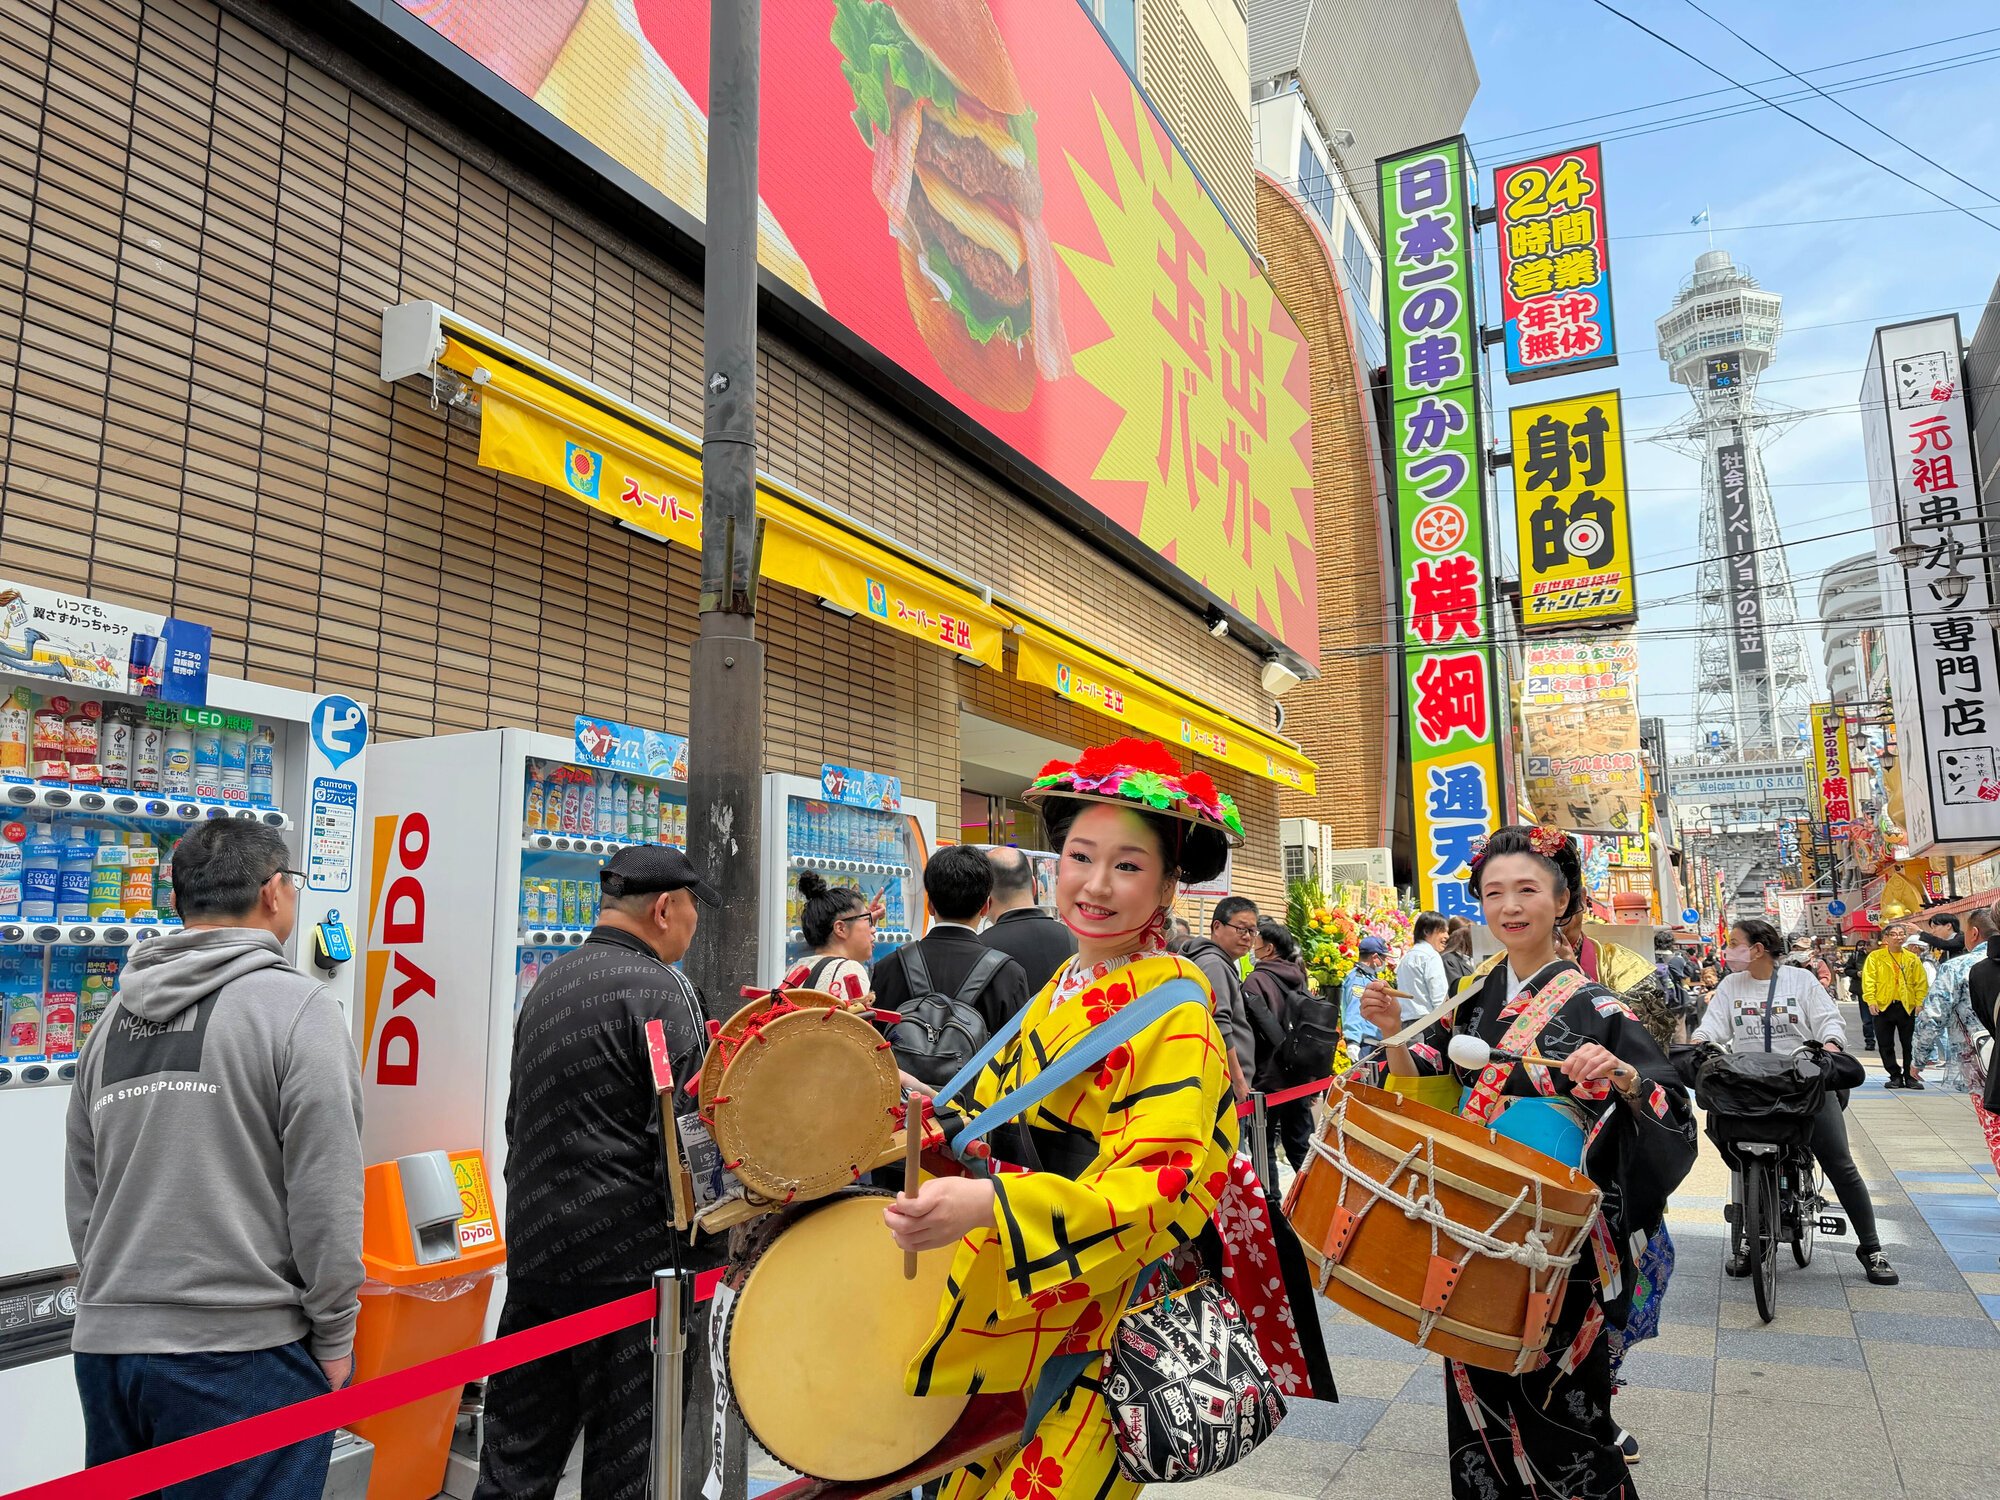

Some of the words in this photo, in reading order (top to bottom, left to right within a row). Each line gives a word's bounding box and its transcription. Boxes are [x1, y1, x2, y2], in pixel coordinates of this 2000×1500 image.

[1506, 158, 1593, 222] 24
[1510, 209, 1593, 258] 時間
[1512, 250, 1597, 298] 営業
[1152, 181, 1268, 444] 玉出
[1524, 297, 1593, 331] 年中
[1398, 157, 1468, 499] 日本一の串かつ
[1526, 326, 1596, 360] 無休
[1715, 363, 1728, 372] 19
[1717, 378, 1730, 386] 56
[1156, 357, 1271, 570] バーガー
[620, 476, 702, 522] スーパー
[1524, 406, 1615, 574] 射的
[1721, 452, 1762, 653] 社会イノベーションの日立
[1533, 573, 1620, 594] 新世界遊技場
[56, 598, 107, 619] いつでも、
[1532, 588, 1622, 612] チャンピオン
[33, 607, 128, 636] 翼さずかっちゃう?
[897, 600, 972, 650] スーパー玉出
[174, 649, 201, 660] コチラの
[1407, 552, 1488, 744] 横綱
[129, 664, 146, 677] Red
[1076, 679, 1125, 714] スーパー玉出
[186, 709, 221, 726] LED
[321, 705, 361, 753] ピ
[600, 734, 640, 759] プライス
[1194, 730, 1227, 757] スーパー玉出
[579, 753, 640, 770] おいしさは、そのままに。
[320, 780, 352, 790] SUNTORY
[836, 776, 862, 796] プライス
[1699, 782, 1735, 792] Welcome
[1756, 776, 1804, 788] OSAKA
[1822, 777, 1850, 822] 横綱
[28, 872, 56, 880] POCA
[62, 875, 90, 883] POCA
[62, 880, 90, 888] SWEA
[376, 812, 436, 1086] DyDo
[129, 1022, 166, 1041] FACE
[118, 1083, 148, 1100] STOP
[461, 1227, 492, 1242] DyDo
